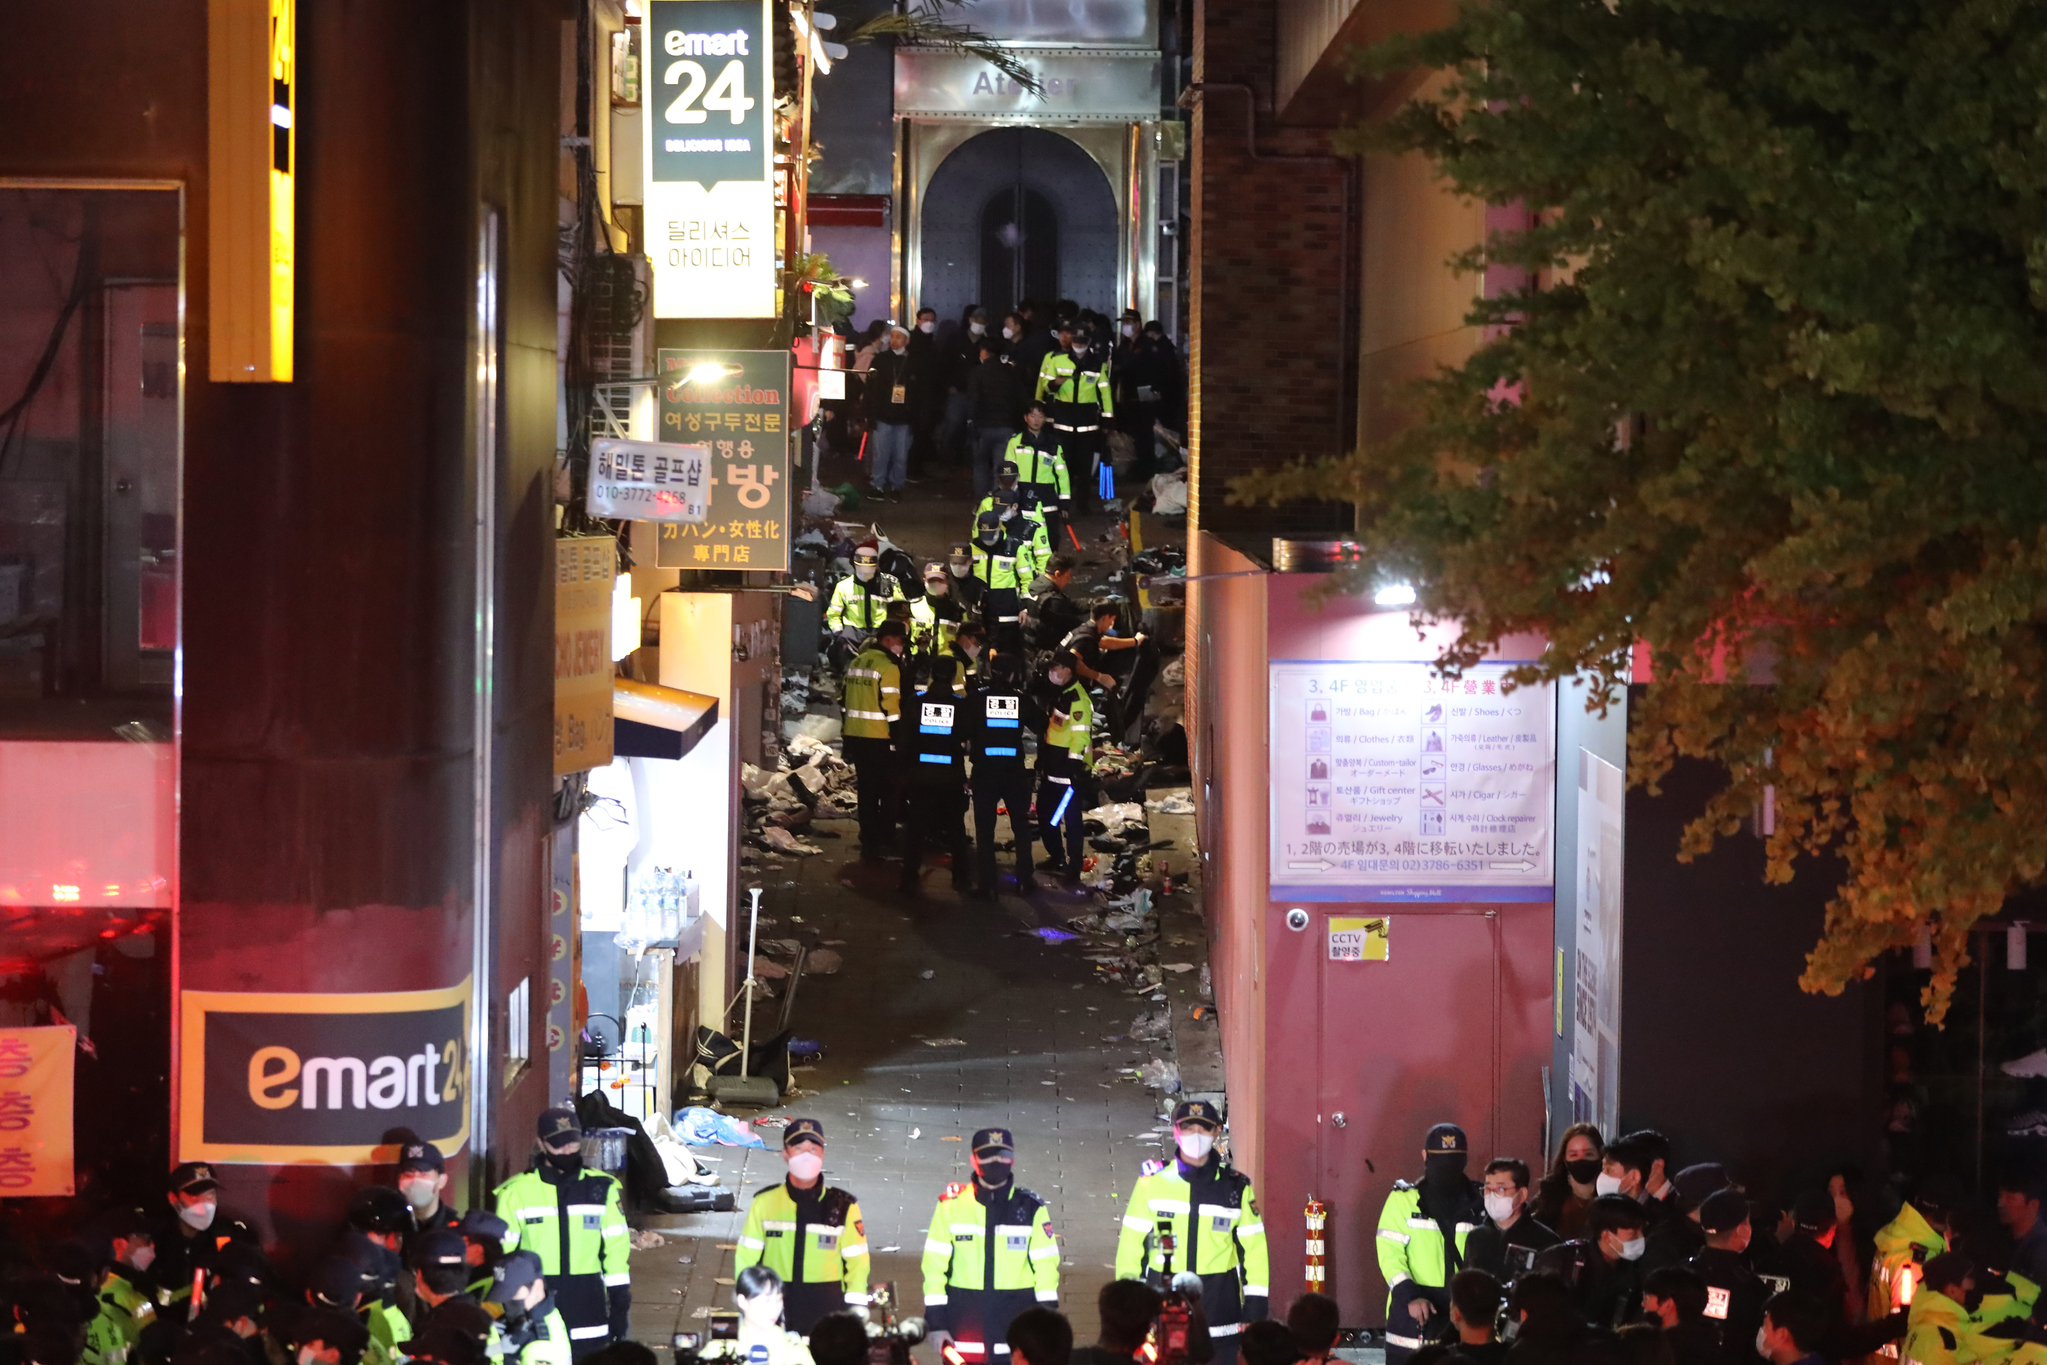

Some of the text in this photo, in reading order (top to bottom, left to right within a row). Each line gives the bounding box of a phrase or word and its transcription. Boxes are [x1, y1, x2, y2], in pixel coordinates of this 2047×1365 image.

[664, 29, 750, 56] emart
[972, 68, 1077, 96] Ateier
[664, 59, 755, 125] 24
[668, 220, 751, 241] 딜리셔스
[668, 246, 751, 268] 아이디어
[666, 384, 781, 405] Collection
[664, 412, 781, 433] 여성구두전문
[598, 451, 703, 487] 해밀톤 골프샵
[1329, 679, 1349, 692] 4F
[1441, 679, 1460, 693] 4F
[1336, 707, 1351, 717] 가방
[1359, 708, 1375, 718] Bag
[1451, 707, 1467, 716] 신발
[1474, 707, 1500, 717] Shoes
[1506, 708, 1522, 716] くつ
[1335, 735, 1351, 744] 의류
[1358, 735, 1390, 744] Clothes
[1483, 734, 1509, 743] Leather
[1368, 758, 1417, 768] Custom-tailor
[1450, 763, 1466, 772] 안경
[1472, 763, 1502, 772] Glasses
[1369, 786, 1386, 795] Gift
[1387, 787, 1416, 795] center
[1450, 791, 1466, 800] 시가
[1473, 791, 1495, 801] Cigar
[1370, 813, 1404, 825] Jewelry
[1486, 814, 1506, 823] Clock
[1507, 815, 1537, 824] repairer
[1340, 859, 1485, 871] 4F 임대문의 02)3786-6351
[1331, 933, 1361, 943] CCTV
